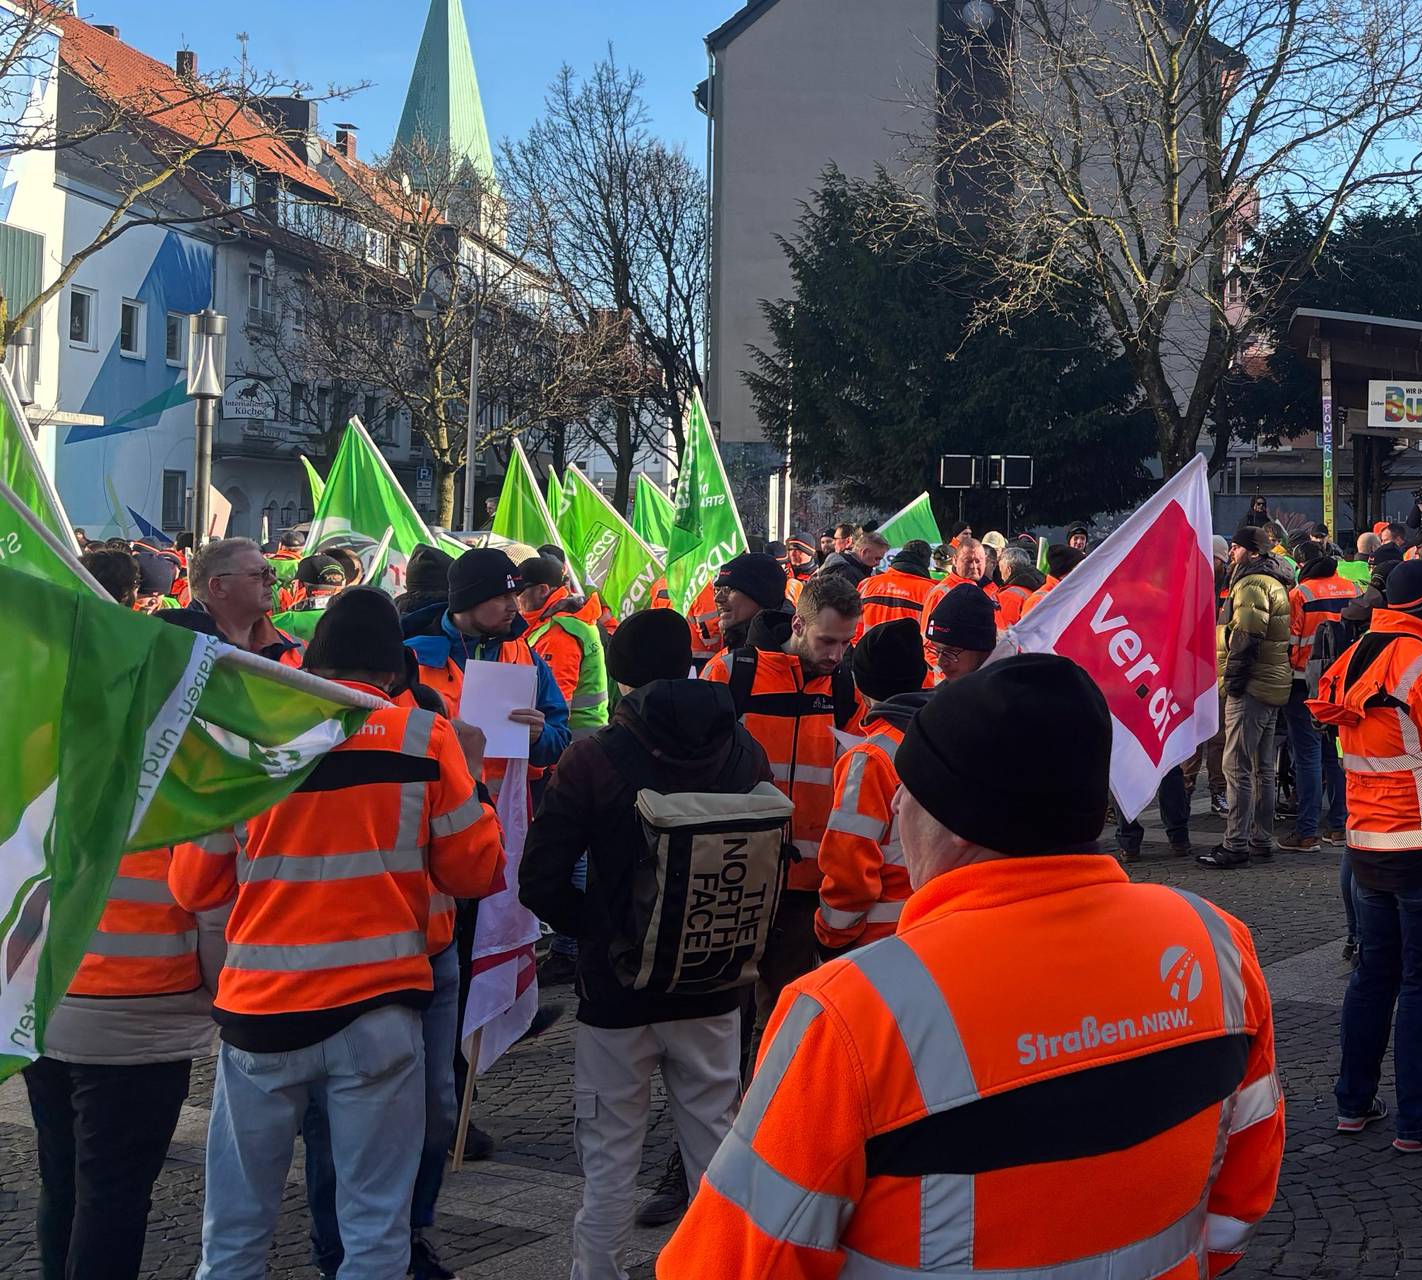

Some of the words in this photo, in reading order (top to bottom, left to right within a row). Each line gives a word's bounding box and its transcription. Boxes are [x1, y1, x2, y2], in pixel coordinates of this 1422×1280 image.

[1323, 403, 1332, 454] POWER
[1089, 592, 1181, 742] ver.di
[142, 728, 178, 779] und
[684, 873, 720, 950] FACE
[711, 838, 748, 951] NORTH
[736, 883, 767, 943] THE
